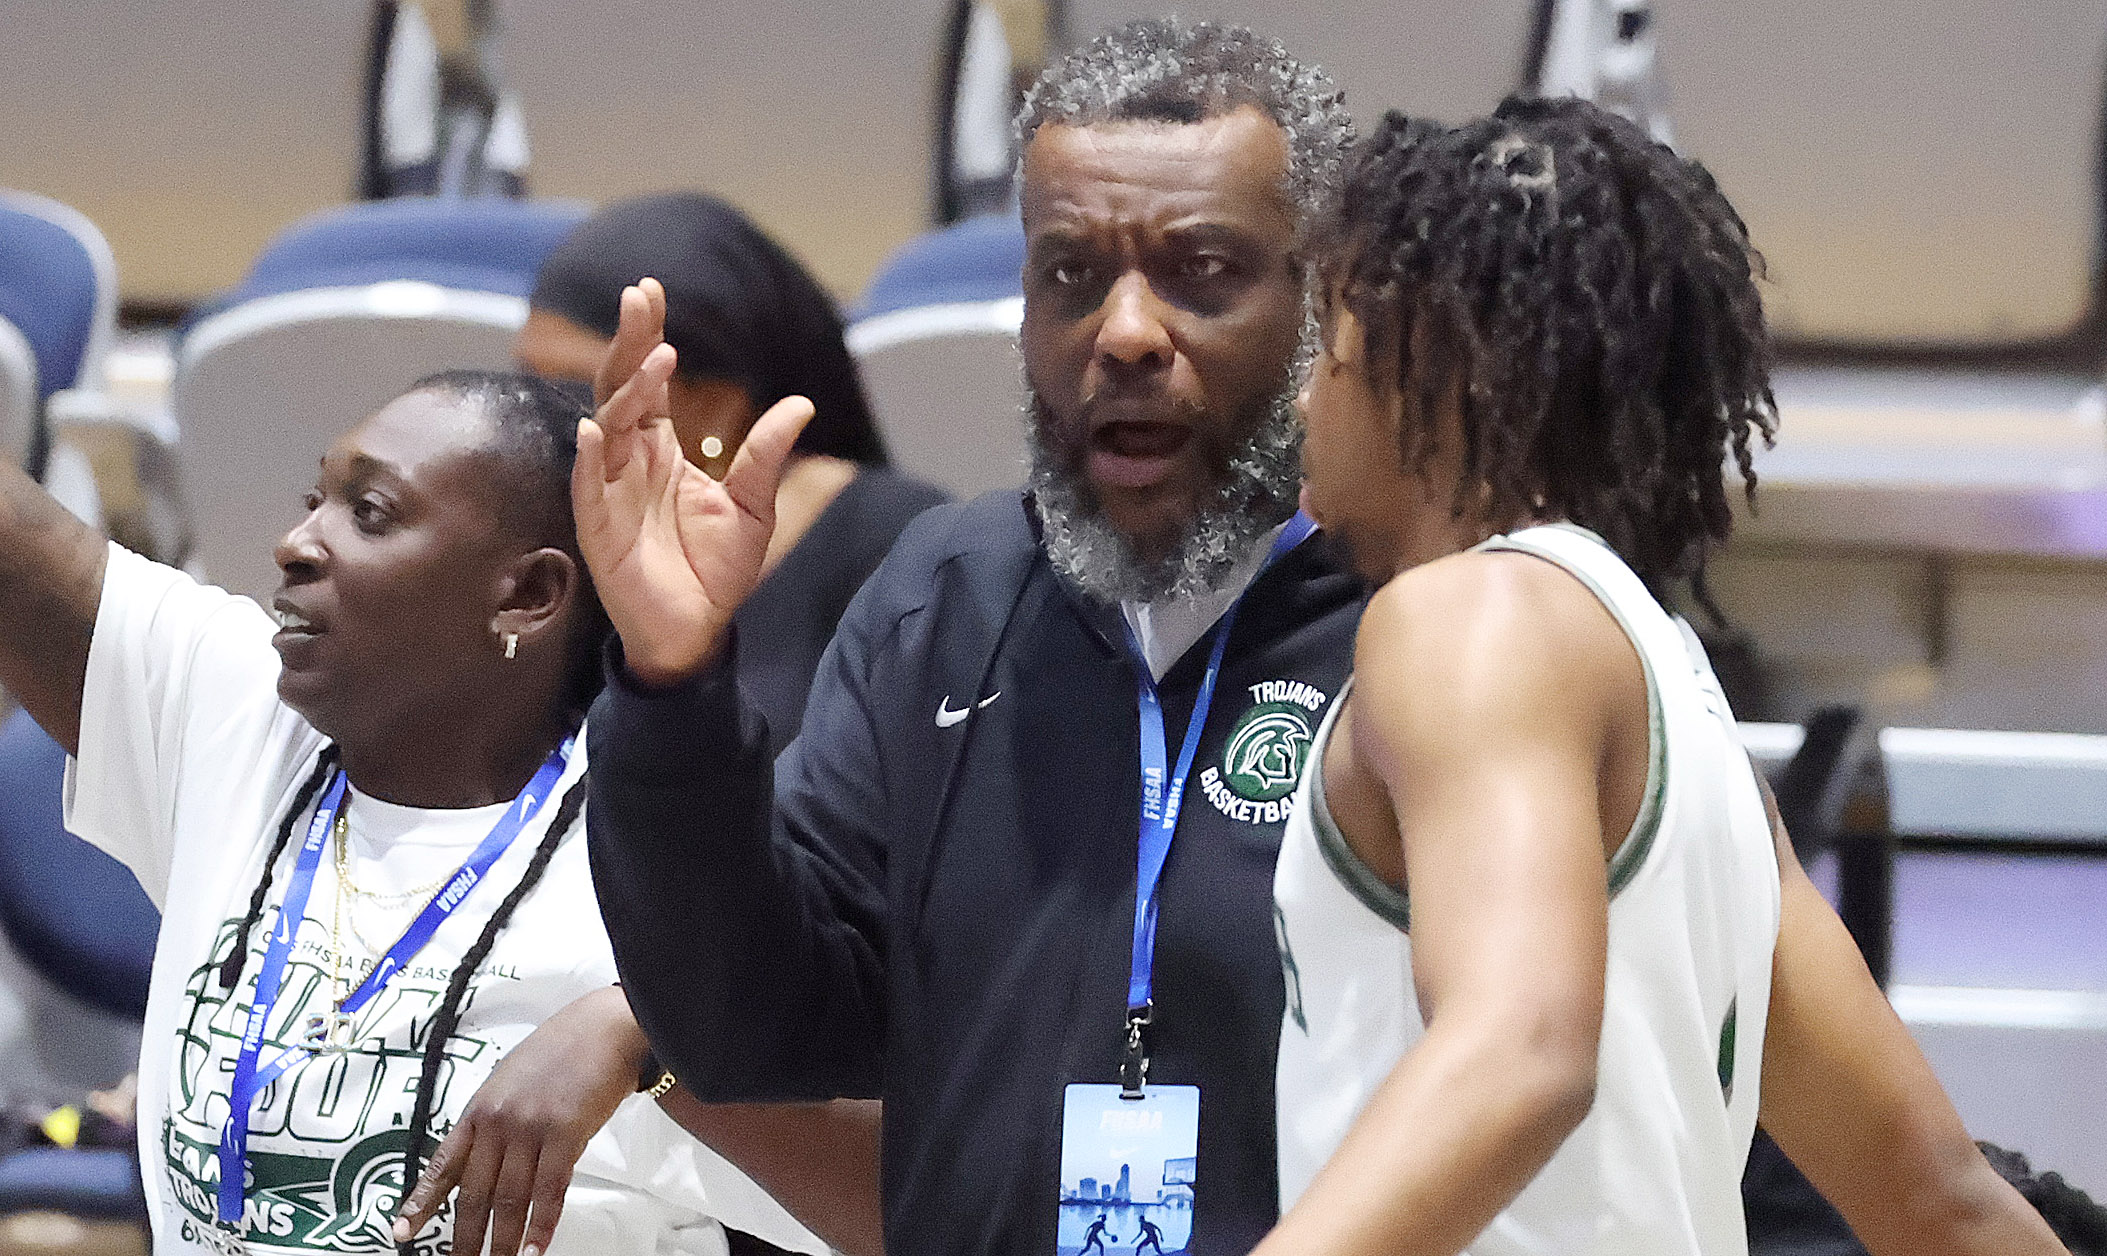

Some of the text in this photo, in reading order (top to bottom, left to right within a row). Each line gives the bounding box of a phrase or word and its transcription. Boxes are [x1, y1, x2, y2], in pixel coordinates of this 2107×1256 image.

[1248, 680, 1326, 711] TROJANS
[1144, 767, 1162, 820] FHSAA
[1200, 766, 1298, 825] BASKETBA
[436, 866, 479, 913] FHSAA
[413, 964, 522, 982] BASALL
[167, 1165, 296, 1238] TRONS
